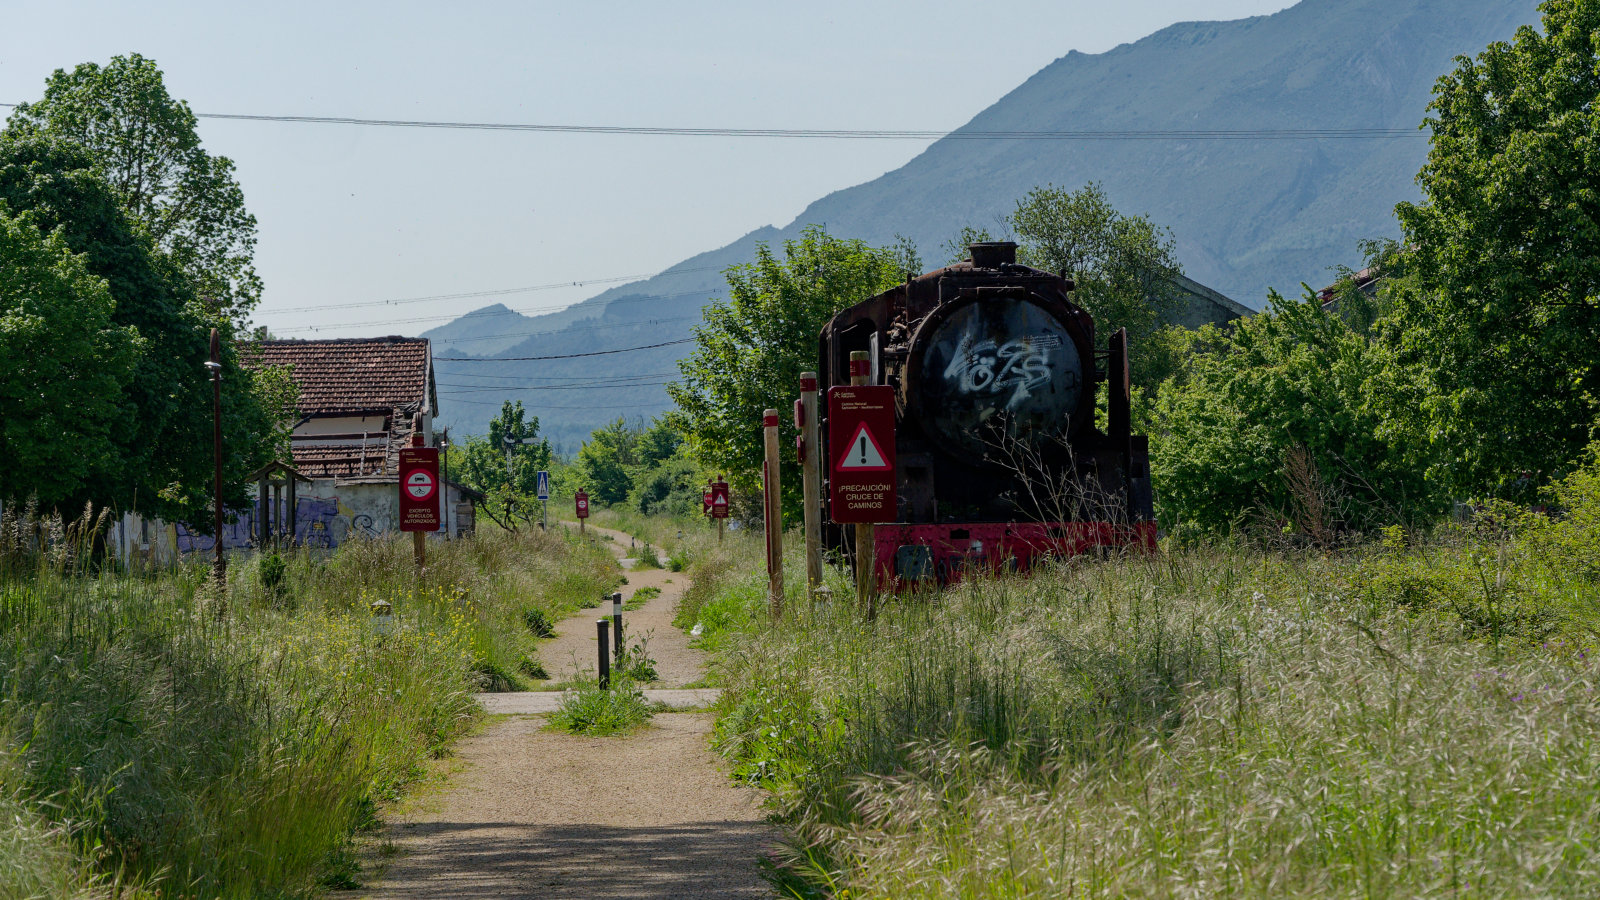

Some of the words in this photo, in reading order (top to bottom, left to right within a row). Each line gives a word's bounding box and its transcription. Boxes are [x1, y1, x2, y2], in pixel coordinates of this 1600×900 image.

[838, 483, 891, 494] ¡PRECAUCIÓN!
[845, 493, 872, 501] CRUCE
[847, 501, 883, 510] CAMINOS
